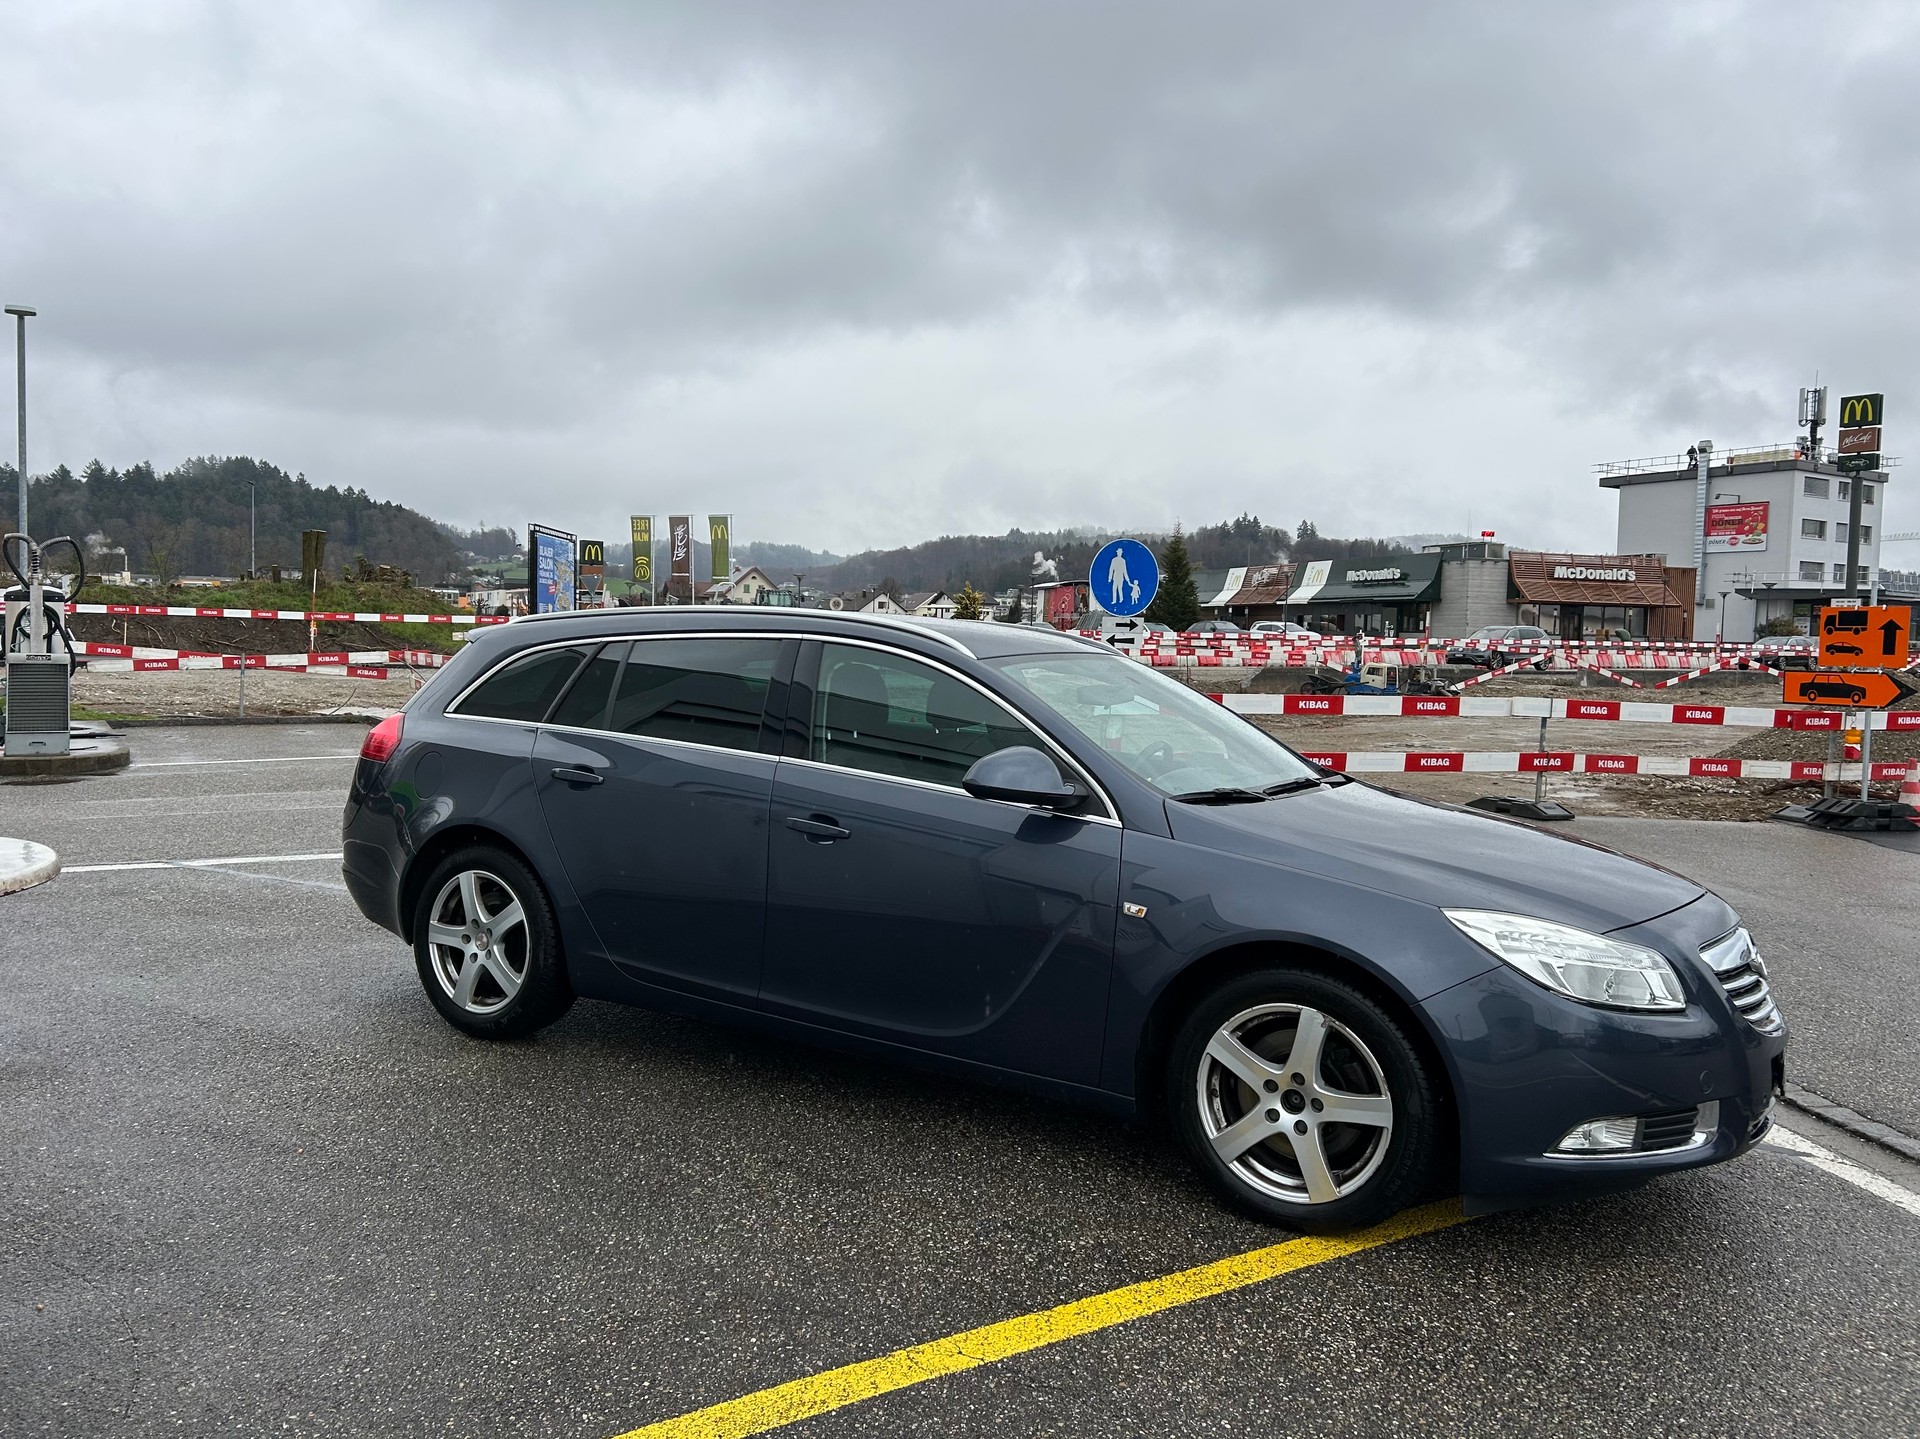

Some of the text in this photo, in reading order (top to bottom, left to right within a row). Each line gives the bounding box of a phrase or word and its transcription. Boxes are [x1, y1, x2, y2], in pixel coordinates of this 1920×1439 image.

[1345, 567, 1401, 582] McDonald's
[1553, 565, 1636, 581] McDonald's
[97, 647, 122, 655] KIBAG
[356, 669, 378, 677] KIBAG
[1298, 700, 1329, 710] KIBAG
[1416, 702, 1447, 711] KIBAG
[1580, 705, 1608, 715] KIBAG
[1685, 710, 1713, 719] KIBAG
[1805, 717, 1830, 726] KIBAG
[1309, 757, 1333, 766] BAG
[1420, 757, 1450, 766] KIBAG
[1533, 757, 1562, 766] KIBAG
[1597, 759, 1625, 769] KIBAG
[1701, 763, 1728, 772] KIBAG
[1803, 767, 1823, 776] KIBA
[1882, 767, 1906, 776] KIBAG
